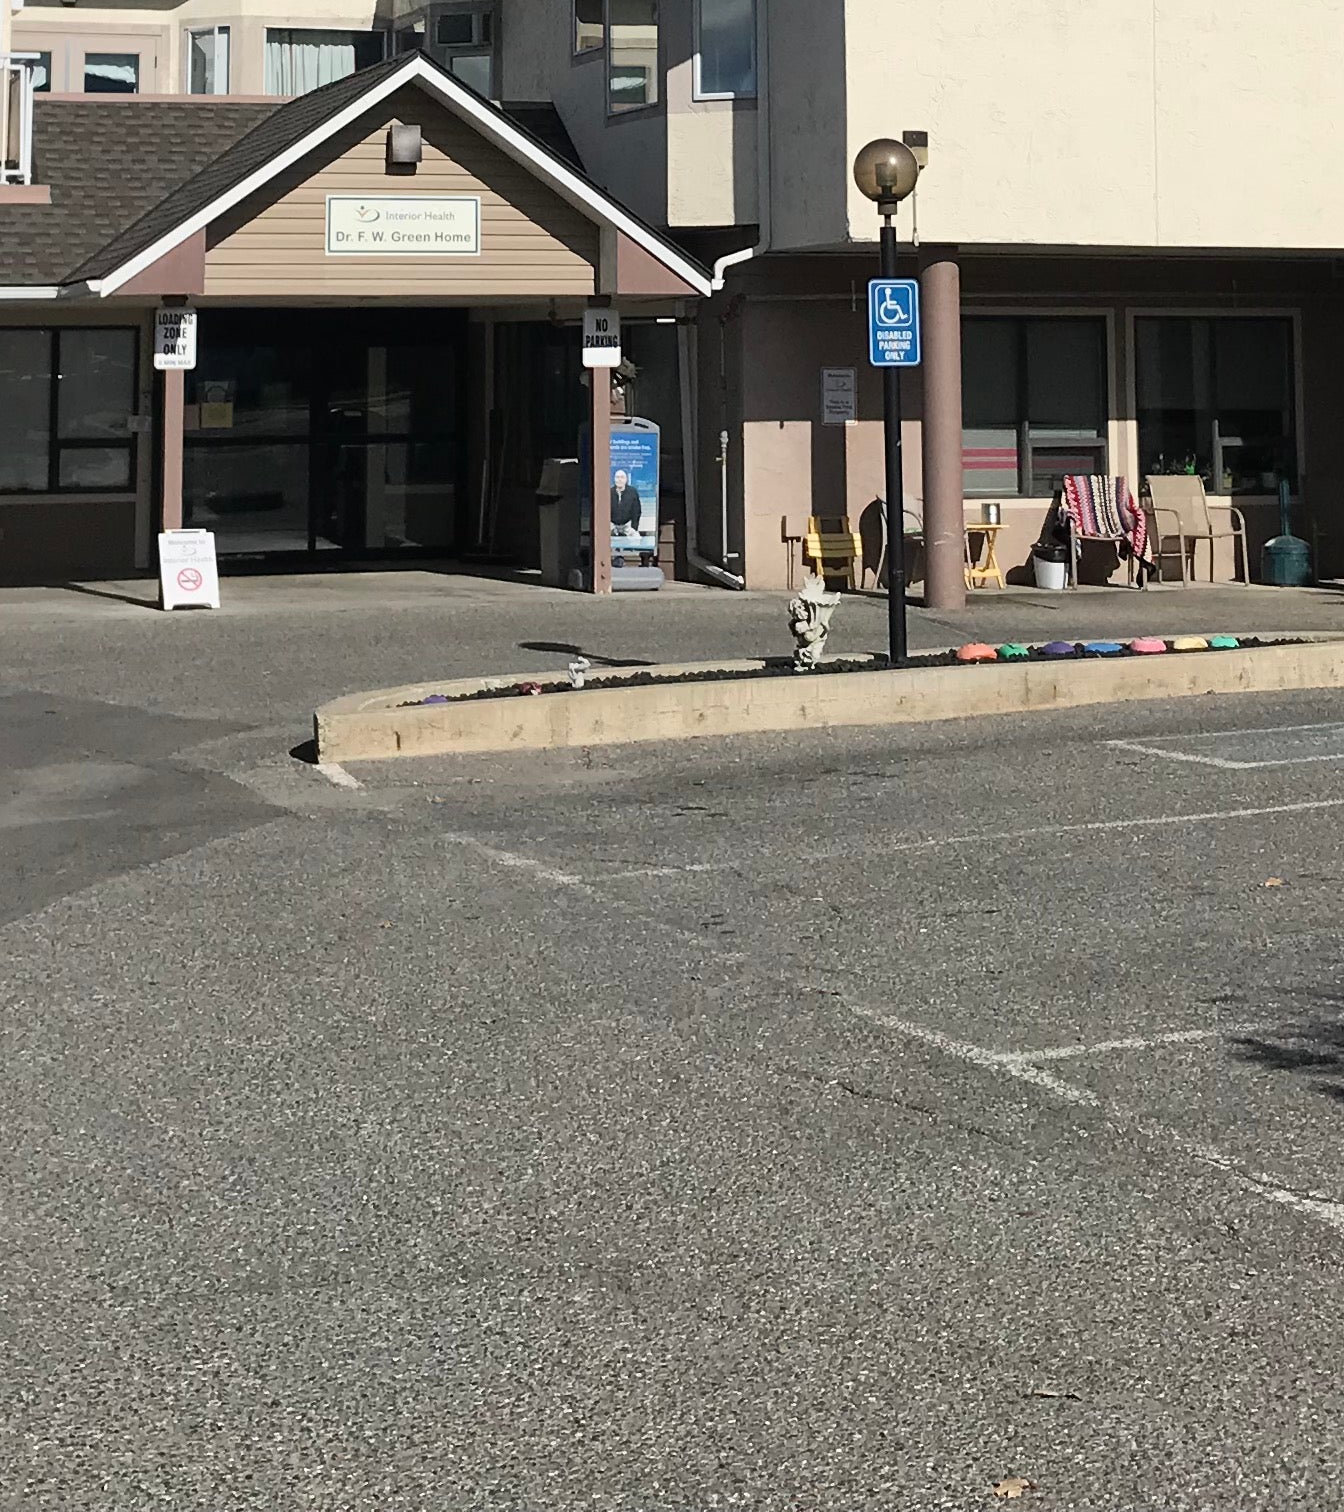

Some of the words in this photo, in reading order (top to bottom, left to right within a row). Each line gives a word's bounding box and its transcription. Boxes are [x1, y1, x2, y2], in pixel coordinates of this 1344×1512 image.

[385, 211, 422, 221] Interior
[424, 211, 455, 221] Health
[335, 231, 354, 243] Dr.
[358, 231, 368, 243] F.
[371, 231, 387, 243] W.
[391, 231, 431, 243] Green
[434, 231, 472, 243] Home
[158, 313, 194, 326] LOADING
[595, 318, 608, 332] NO
[163, 327, 187, 340] ZONE
[876, 330, 913, 340] DISABLED
[585, 334, 618, 348] PARKING
[878, 340, 911, 350] PARKING
[163, 343, 187, 356] ONLY
[884, 351, 906, 361] ONLY
